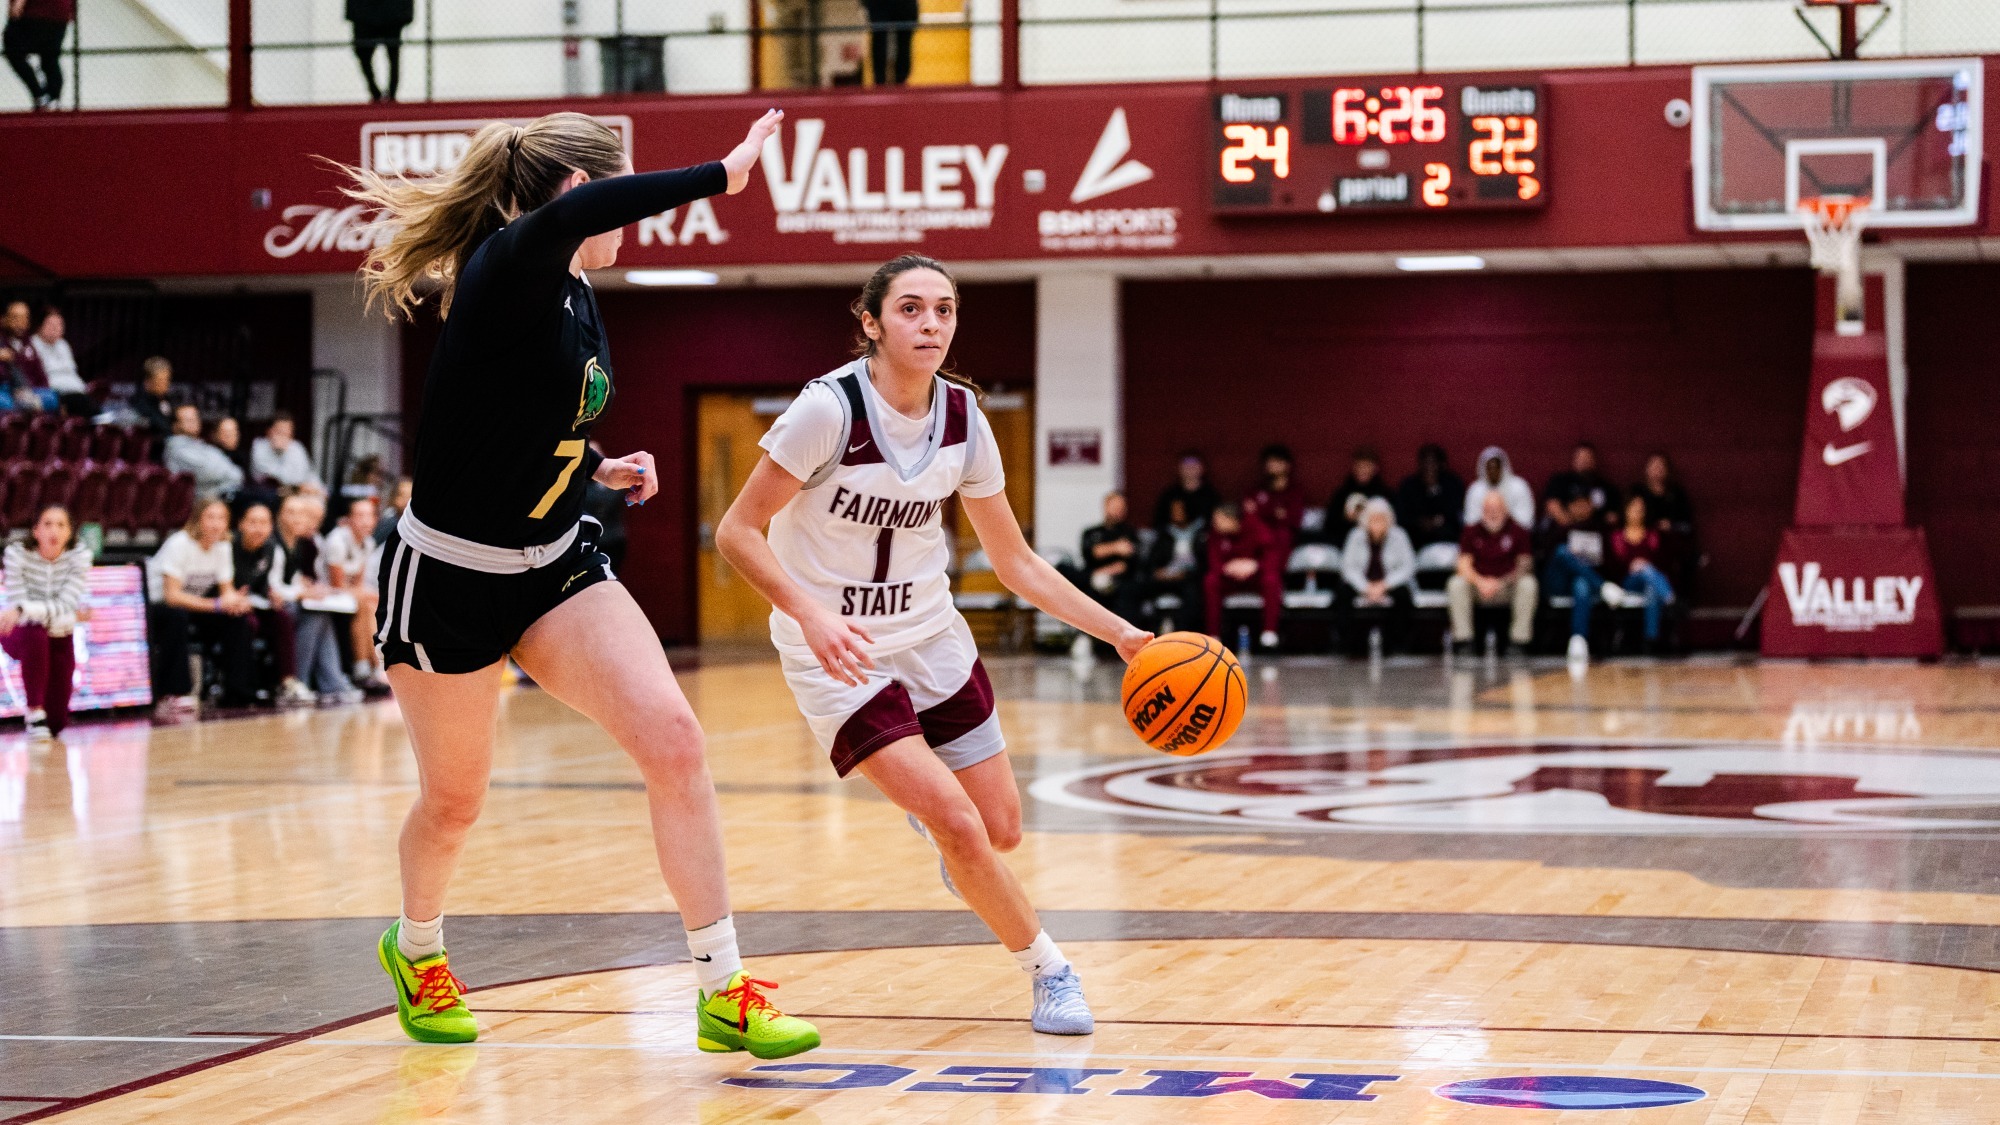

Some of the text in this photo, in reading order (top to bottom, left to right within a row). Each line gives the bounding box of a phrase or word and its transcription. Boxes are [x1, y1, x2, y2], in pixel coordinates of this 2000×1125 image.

[1221, 93, 1281, 121] Home
[1332, 86, 1446, 144] 6:26
[375, 133, 471, 174] BUD
[752, 118, 1009, 212] VALLEY
[1220, 125, 1289, 182] 24
[1469, 116, 1538, 174] 22
[1339, 172, 1408, 205] period
[1422, 162, 1451, 207] 2
[264, 204, 402, 258] Mich
[638, 198, 722, 246] RA
[1095, 207, 1178, 235] SPORTS
[527, 439, 586, 519] 7
[872, 527, 894, 583] 1
[840, 582, 913, 617] STATE
[1778, 562, 1923, 616] VALLEY
[1132, 684, 1176, 733] NCAA
[1158, 703, 1217, 753] Wilson
[720, 1063, 1402, 1101] MEC
